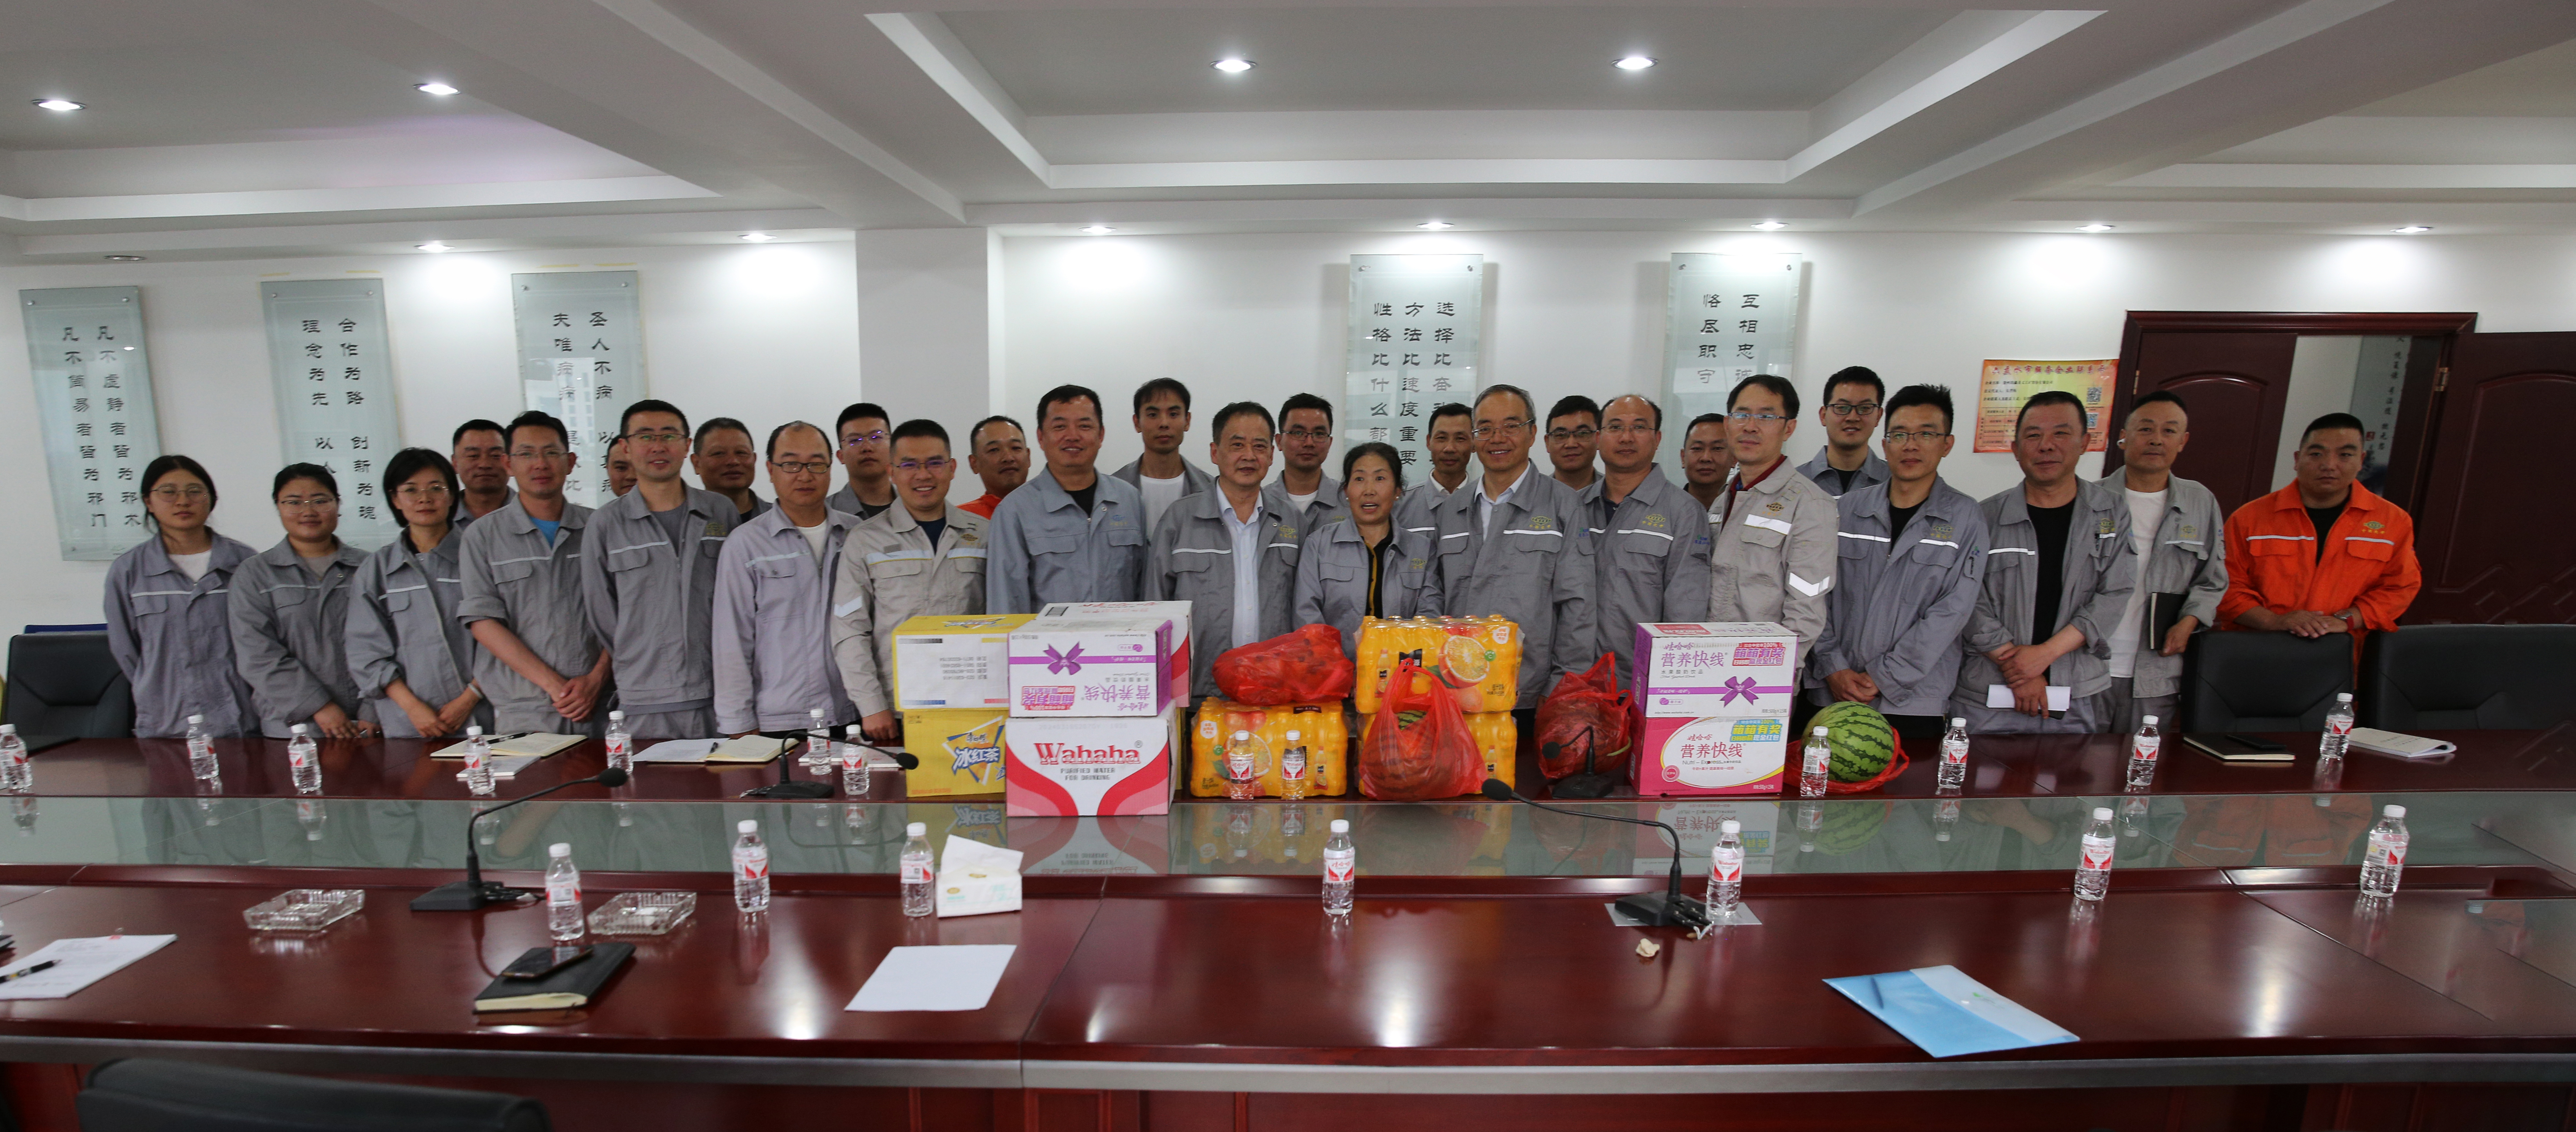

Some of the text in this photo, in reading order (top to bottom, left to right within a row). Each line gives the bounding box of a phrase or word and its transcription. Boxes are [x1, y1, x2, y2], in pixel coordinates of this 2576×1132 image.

[1697, 294, 1722, 384] 恪尽职守
[1735, 294, 1760, 383] 互相忠诚
[302, 319, 329, 406] 理念为先
[553, 312, 576, 401] 夫唯病病
[590, 312, 613, 400] 圣人不病
[1369, 302, 1393, 441] 性格比什么都
[1399, 302, 1424, 466] 方法比速度重要
[338, 318, 377, 520] 合作为路 创新为魂
[1663, 642, 1695, 651] 娃哈哈
[1734, 648, 1784, 658] 箱箱有奖
[1661, 650, 1724, 669] 营养快线
[1022, 694, 1074, 705] 箱箱有奖
[1083, 684, 1150, 702] 营养快线
[1117, 701, 1149, 711] 娃哈哈
[1732, 724, 1782, 734] 箱箱有奖
[952, 747, 1000, 775] 冰红茶
[1033, 743, 1141, 765] Wahaha
[1680, 741, 1743, 760] 营养快线
